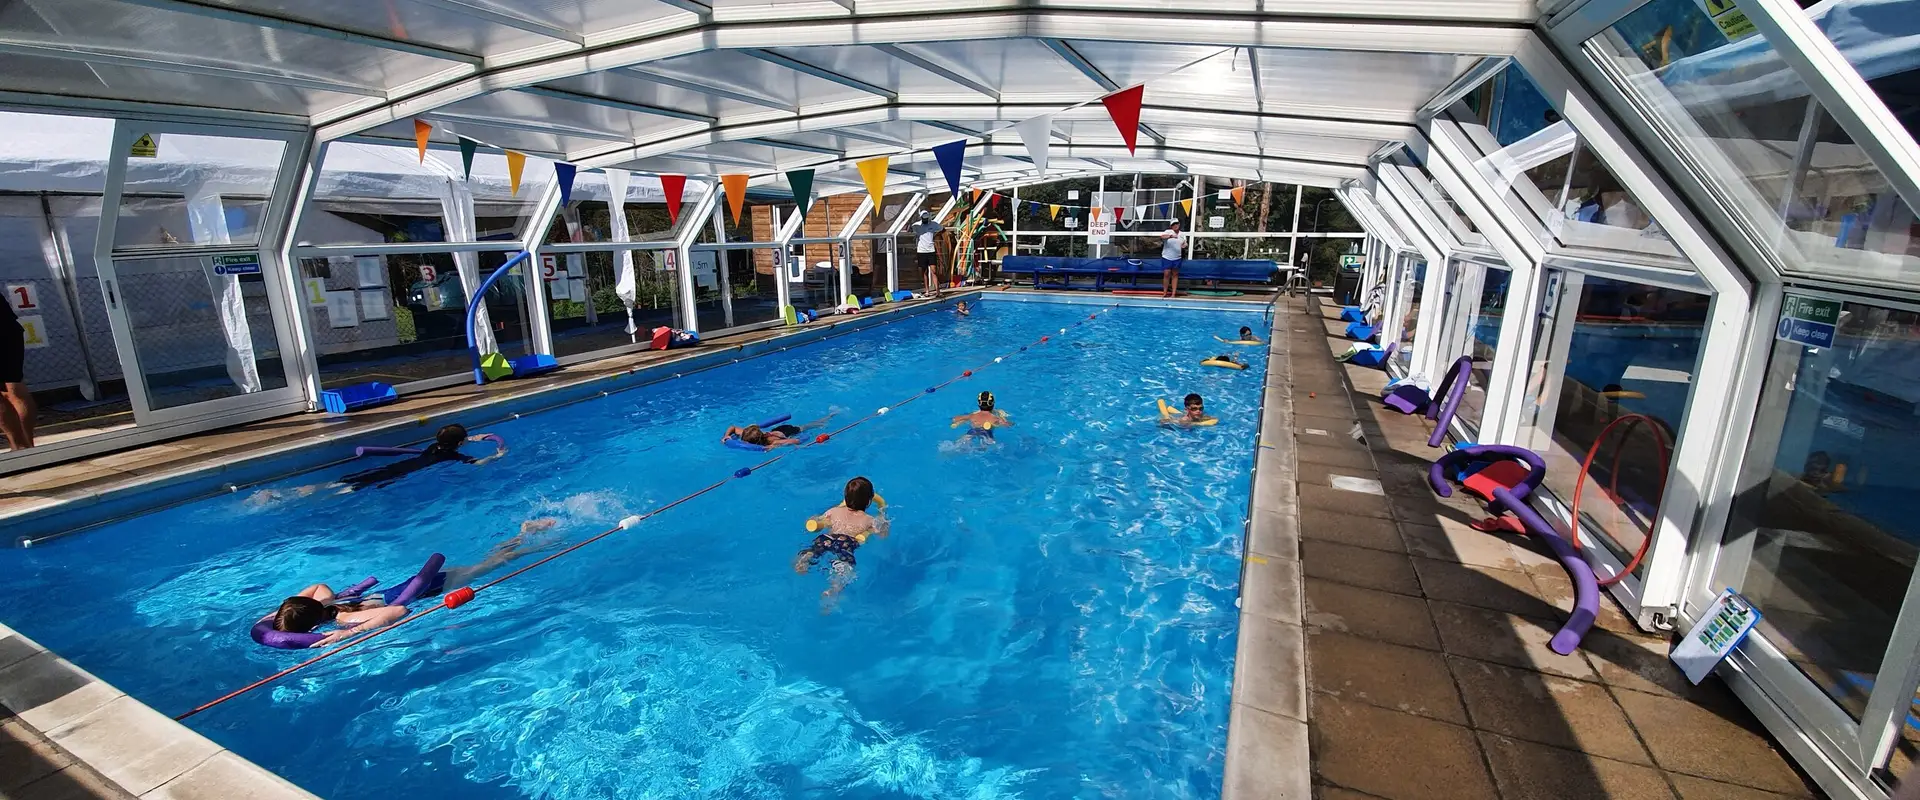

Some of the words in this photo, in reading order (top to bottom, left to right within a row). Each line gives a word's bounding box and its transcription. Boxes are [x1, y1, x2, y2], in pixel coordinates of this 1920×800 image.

[1718, 14, 1749, 29] Caution
[667, 252, 675, 269] 4
[692, 261, 709, 270] 1.5m
[774, 251, 780, 265] 3
[423, 266, 435, 282] 3
[543, 257, 555, 277] 5
[14, 286, 36, 308] 1
[306, 280, 327, 304] 1
[1799, 302, 1814, 315] Fire
[1815, 306, 1831, 318] exit
[24, 322, 43, 344] 1
[1793, 325, 1811, 340] Keep
[1811, 330, 1829, 341] clear
